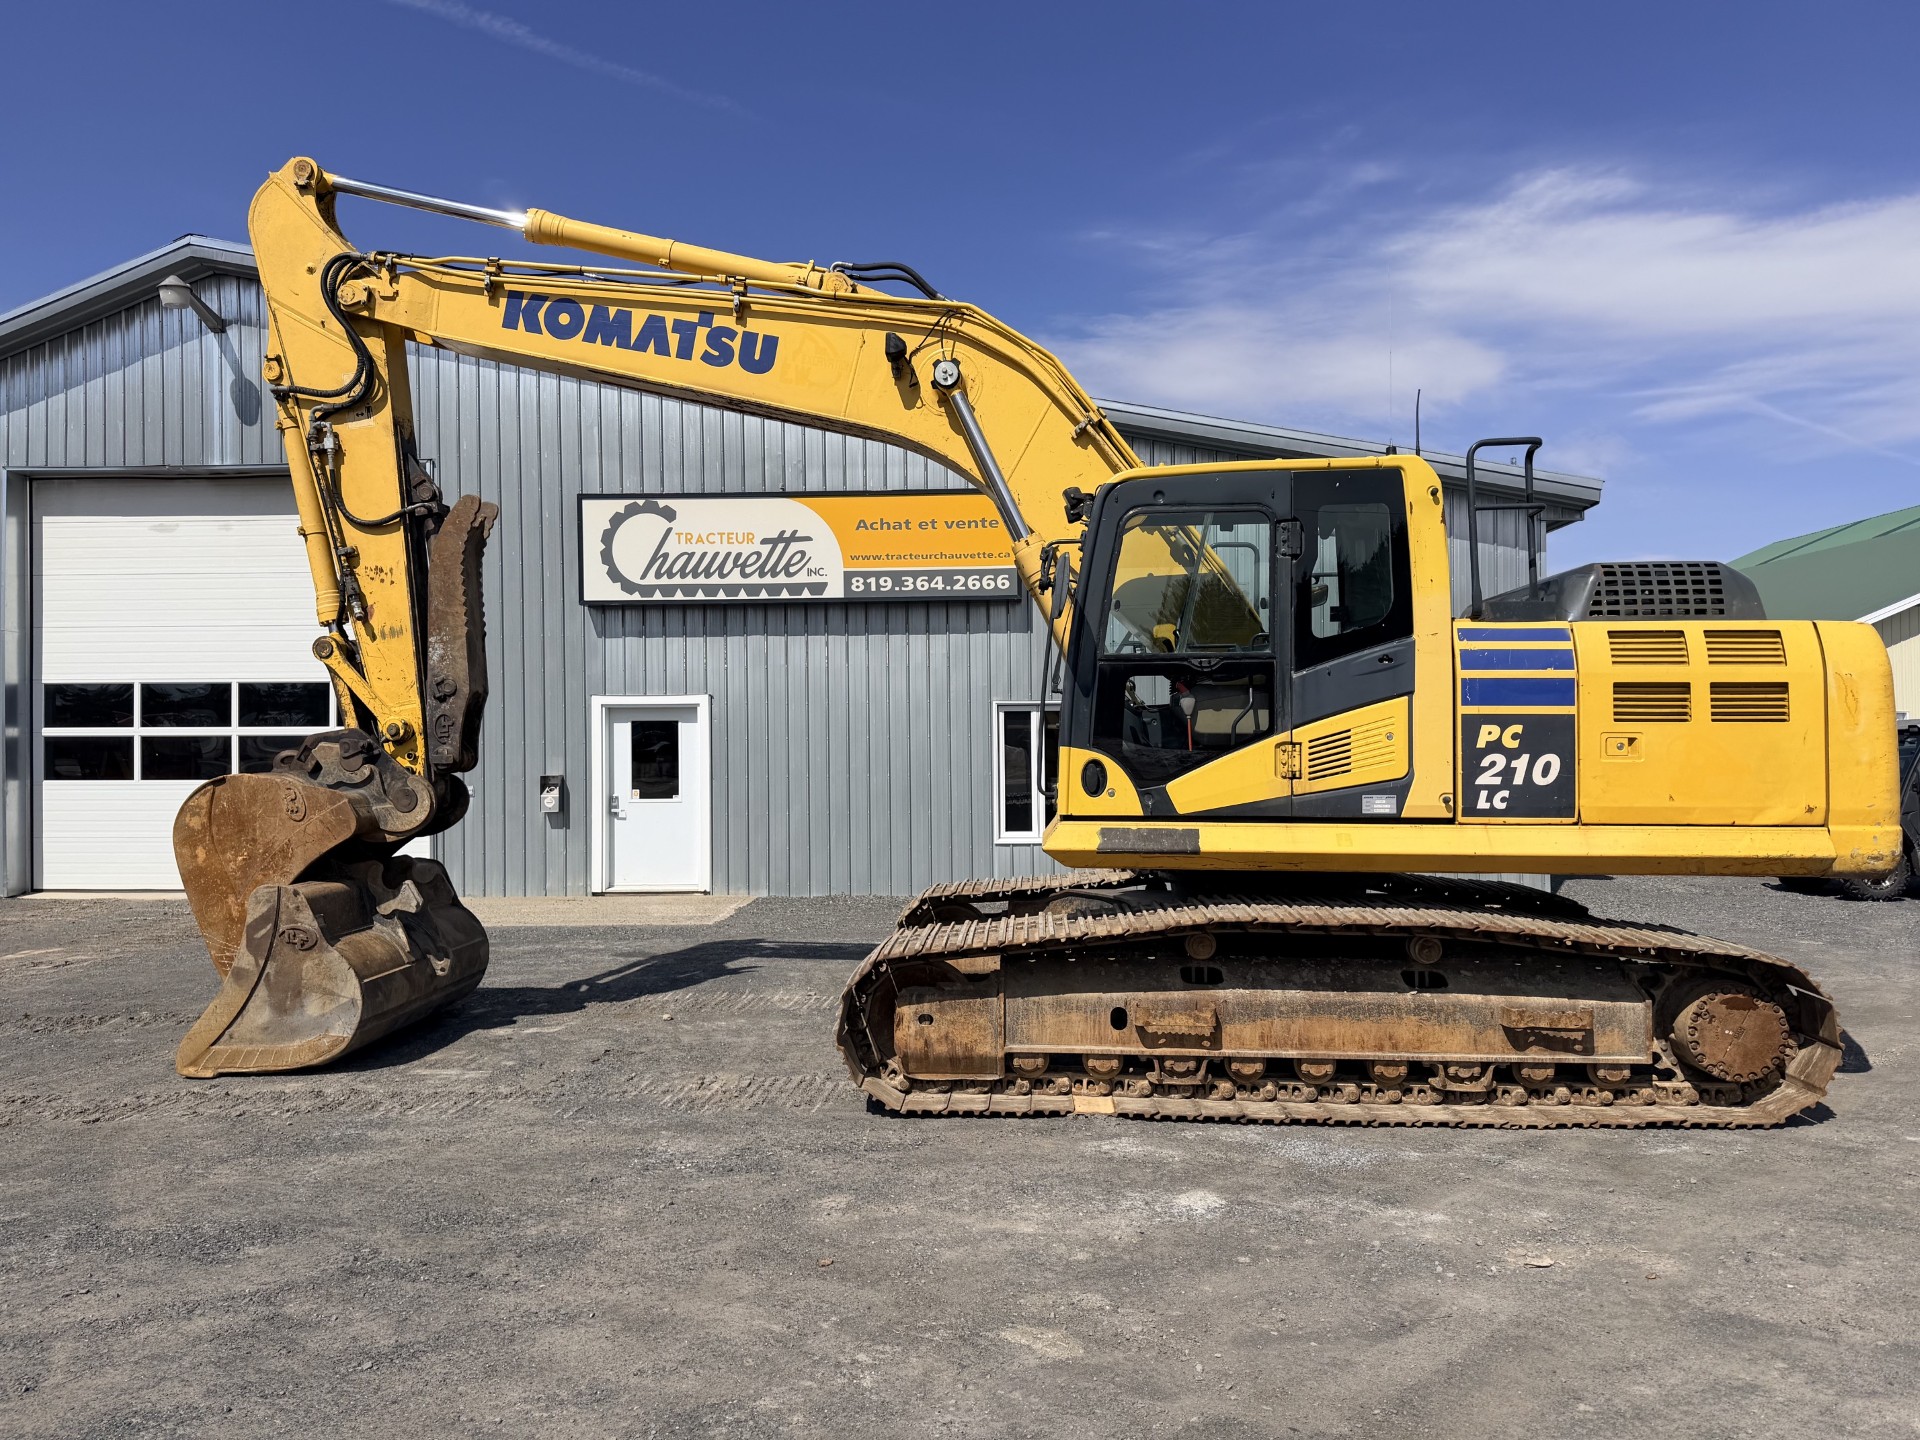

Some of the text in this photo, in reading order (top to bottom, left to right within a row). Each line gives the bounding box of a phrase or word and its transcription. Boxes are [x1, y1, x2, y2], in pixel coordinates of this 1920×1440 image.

[502, 290, 779, 374] KOMATSU
[855, 517, 999, 531] Achat et vente
[675, 532, 755, 545] TRACTEUR
[850, 551, 1011, 561] www.tracteurchauvette.ca
[807, 567, 827, 577] INC.
[851, 575, 1010, 592] 819.364.2666
[1476, 724, 1523, 748] PC
[1475, 753, 1561, 786] 210
[1476, 790, 1510, 809] LC
